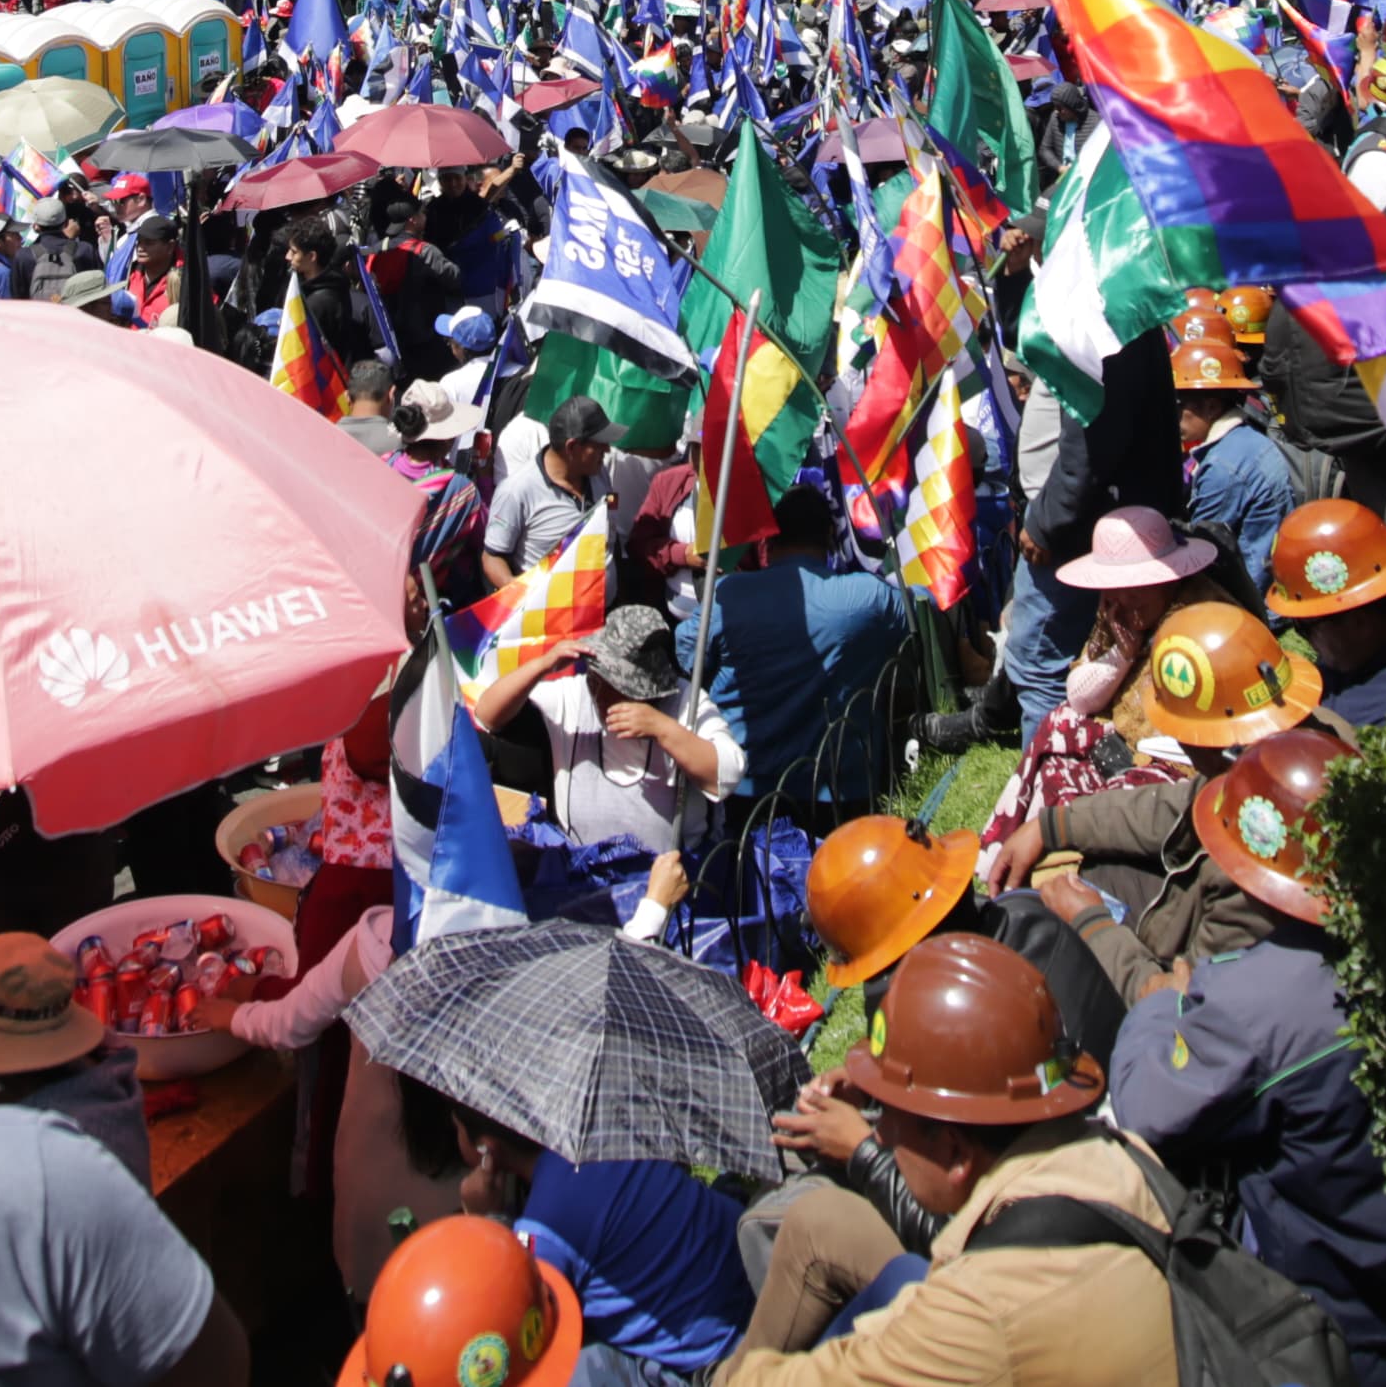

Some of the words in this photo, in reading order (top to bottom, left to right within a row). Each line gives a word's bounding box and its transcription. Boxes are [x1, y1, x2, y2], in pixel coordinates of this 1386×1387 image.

[199, 55, 219, 68] BAÑO
[135, 71, 156, 84] BAÑO
[134, 585, 329, 670] HUAWEI
